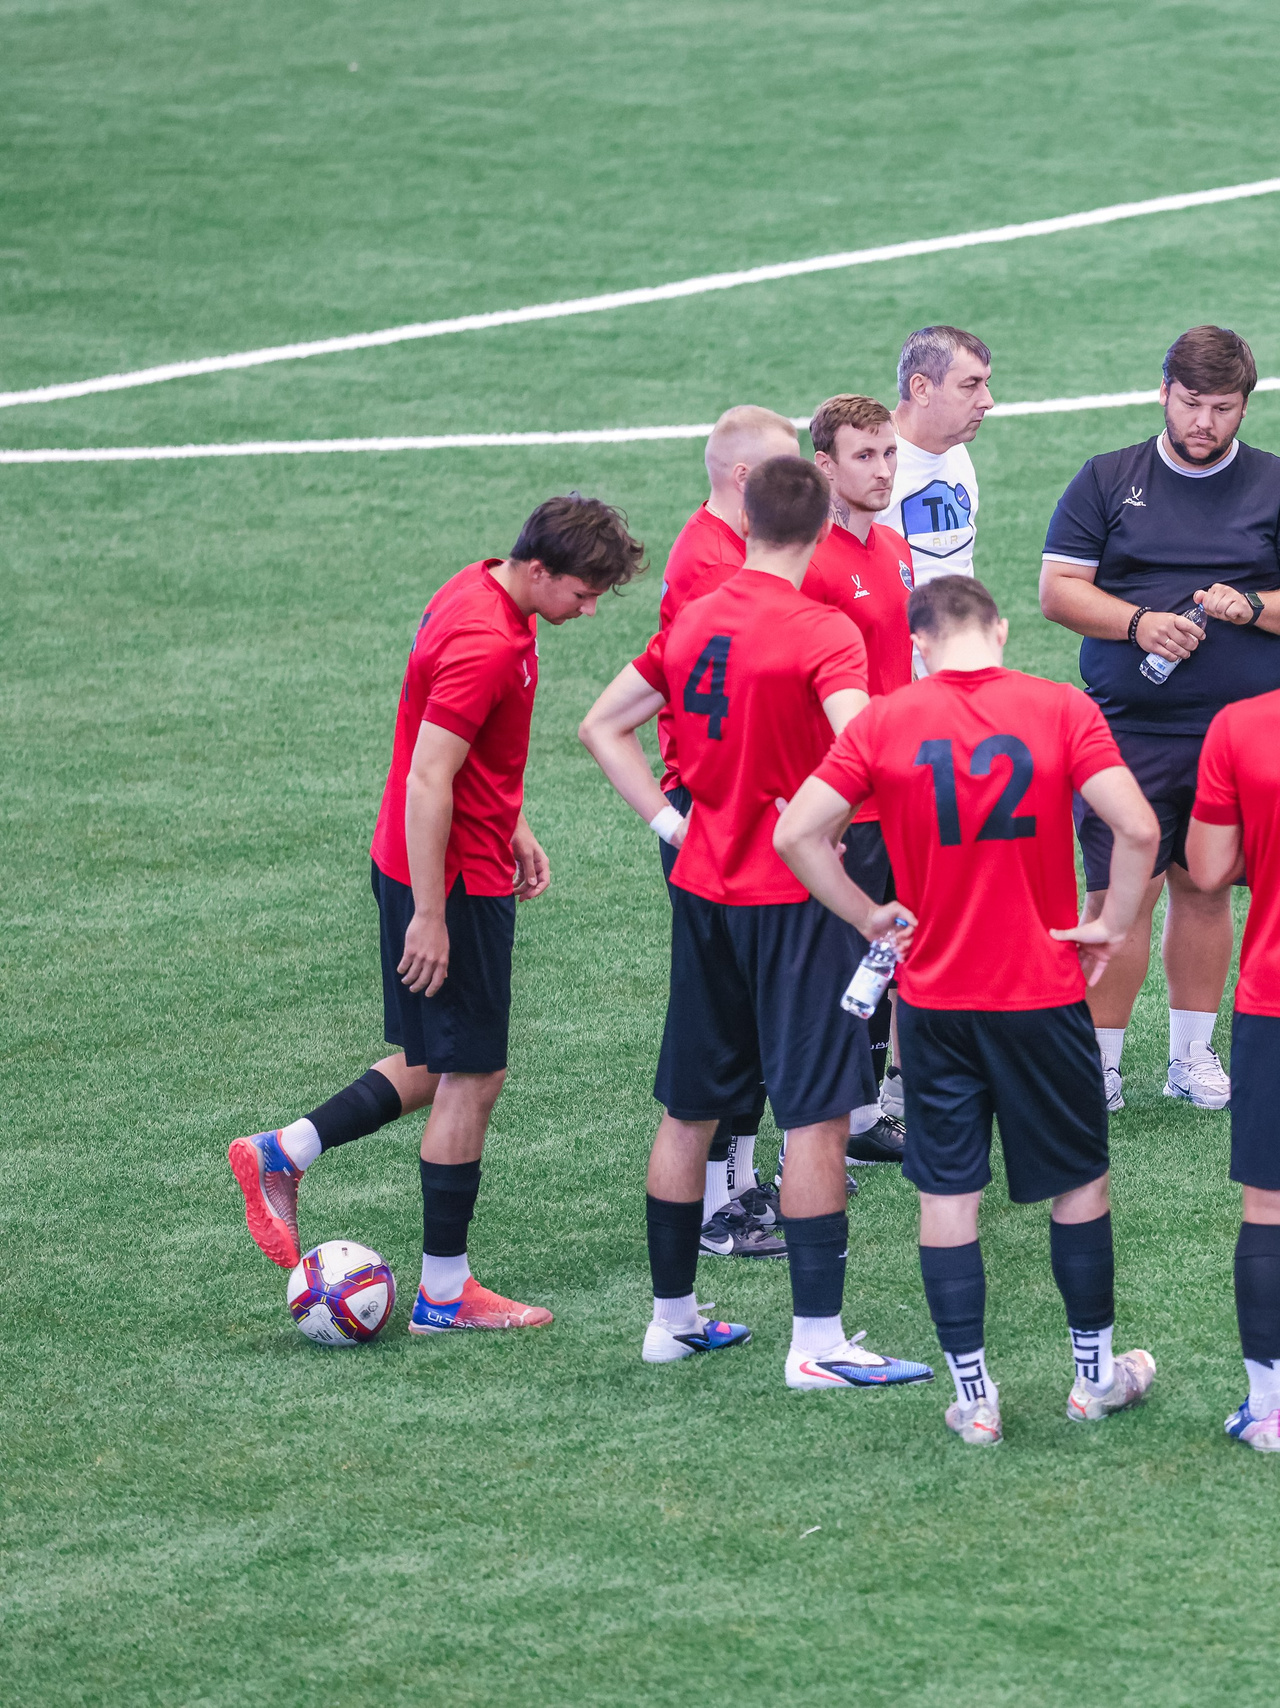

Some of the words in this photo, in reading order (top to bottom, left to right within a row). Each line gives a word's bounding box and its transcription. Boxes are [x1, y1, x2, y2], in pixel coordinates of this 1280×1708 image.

[922, 496, 960, 533] Tn
[932, 534, 960, 548] AIR
[682, 634, 733, 741] 4
[914, 733, 1037, 847] 12
[1072, 1331, 1100, 1383] ELIT
